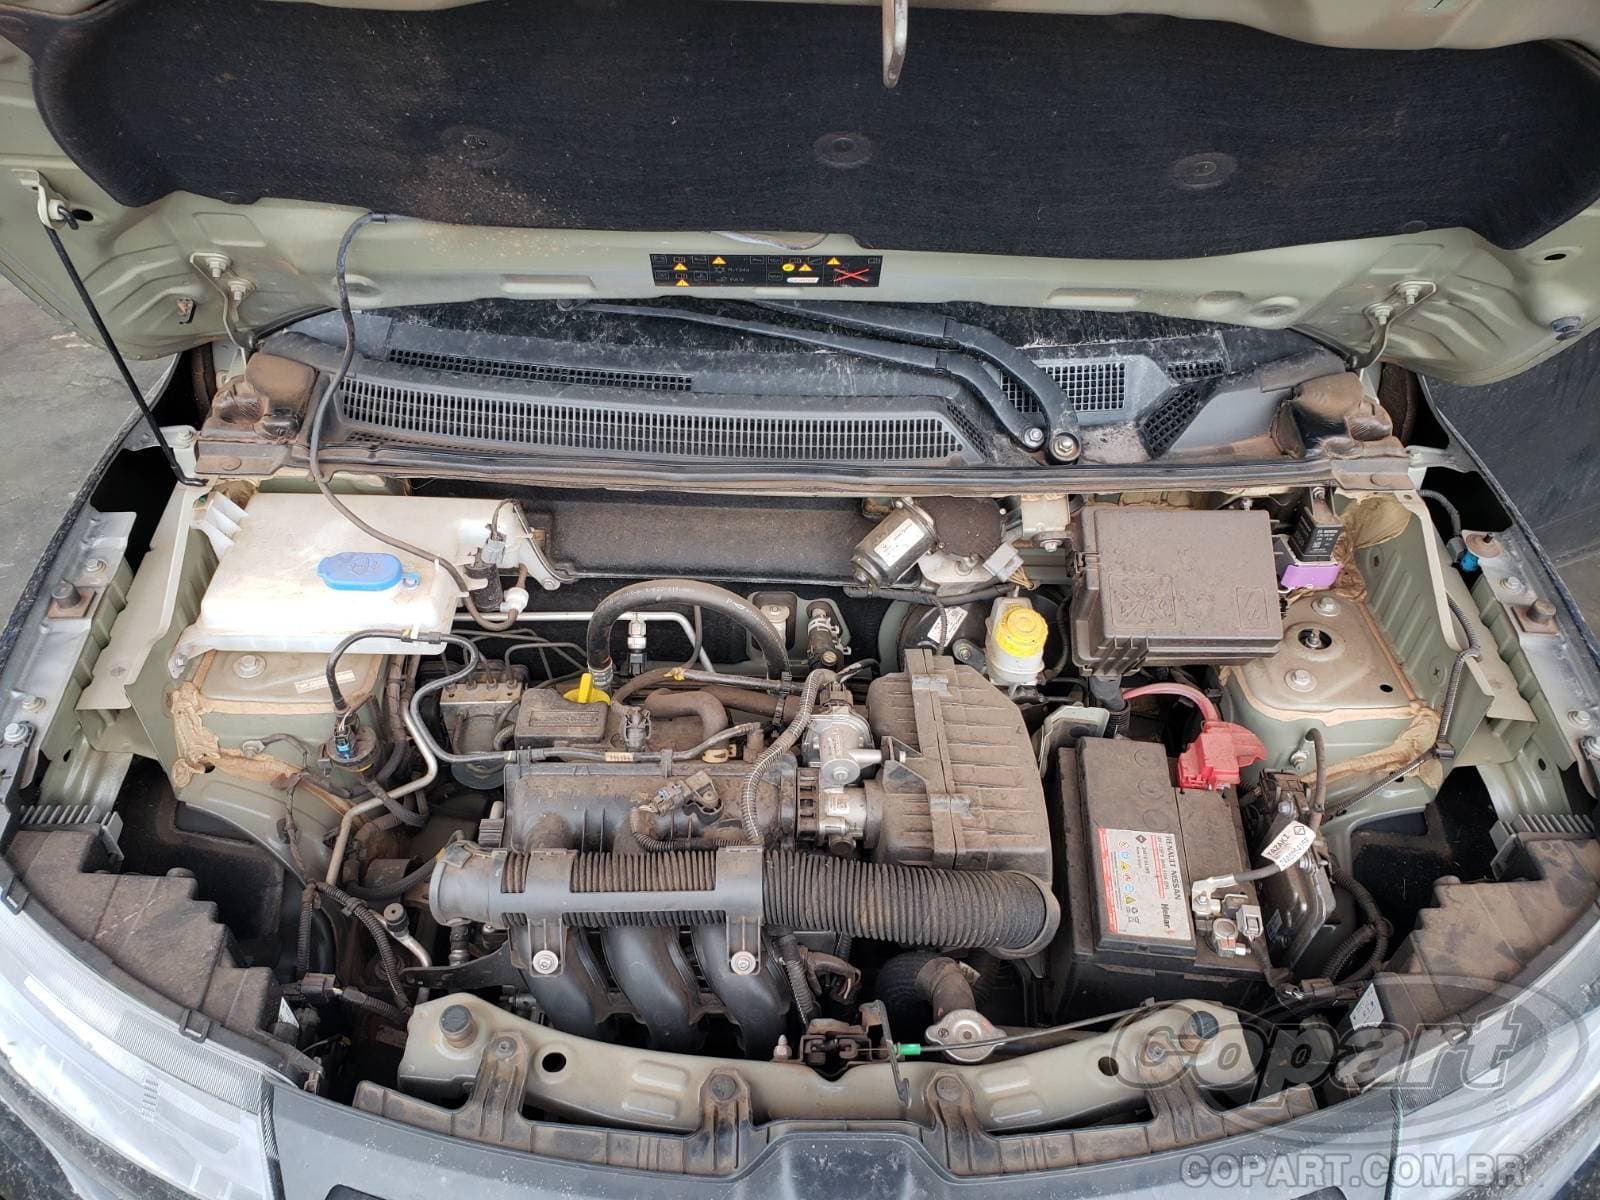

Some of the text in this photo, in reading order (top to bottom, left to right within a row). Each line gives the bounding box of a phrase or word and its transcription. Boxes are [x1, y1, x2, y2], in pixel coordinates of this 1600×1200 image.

[1165, 836, 1182, 901] RENAULT NISSAN
[1161, 903, 1171, 929] Heliar
